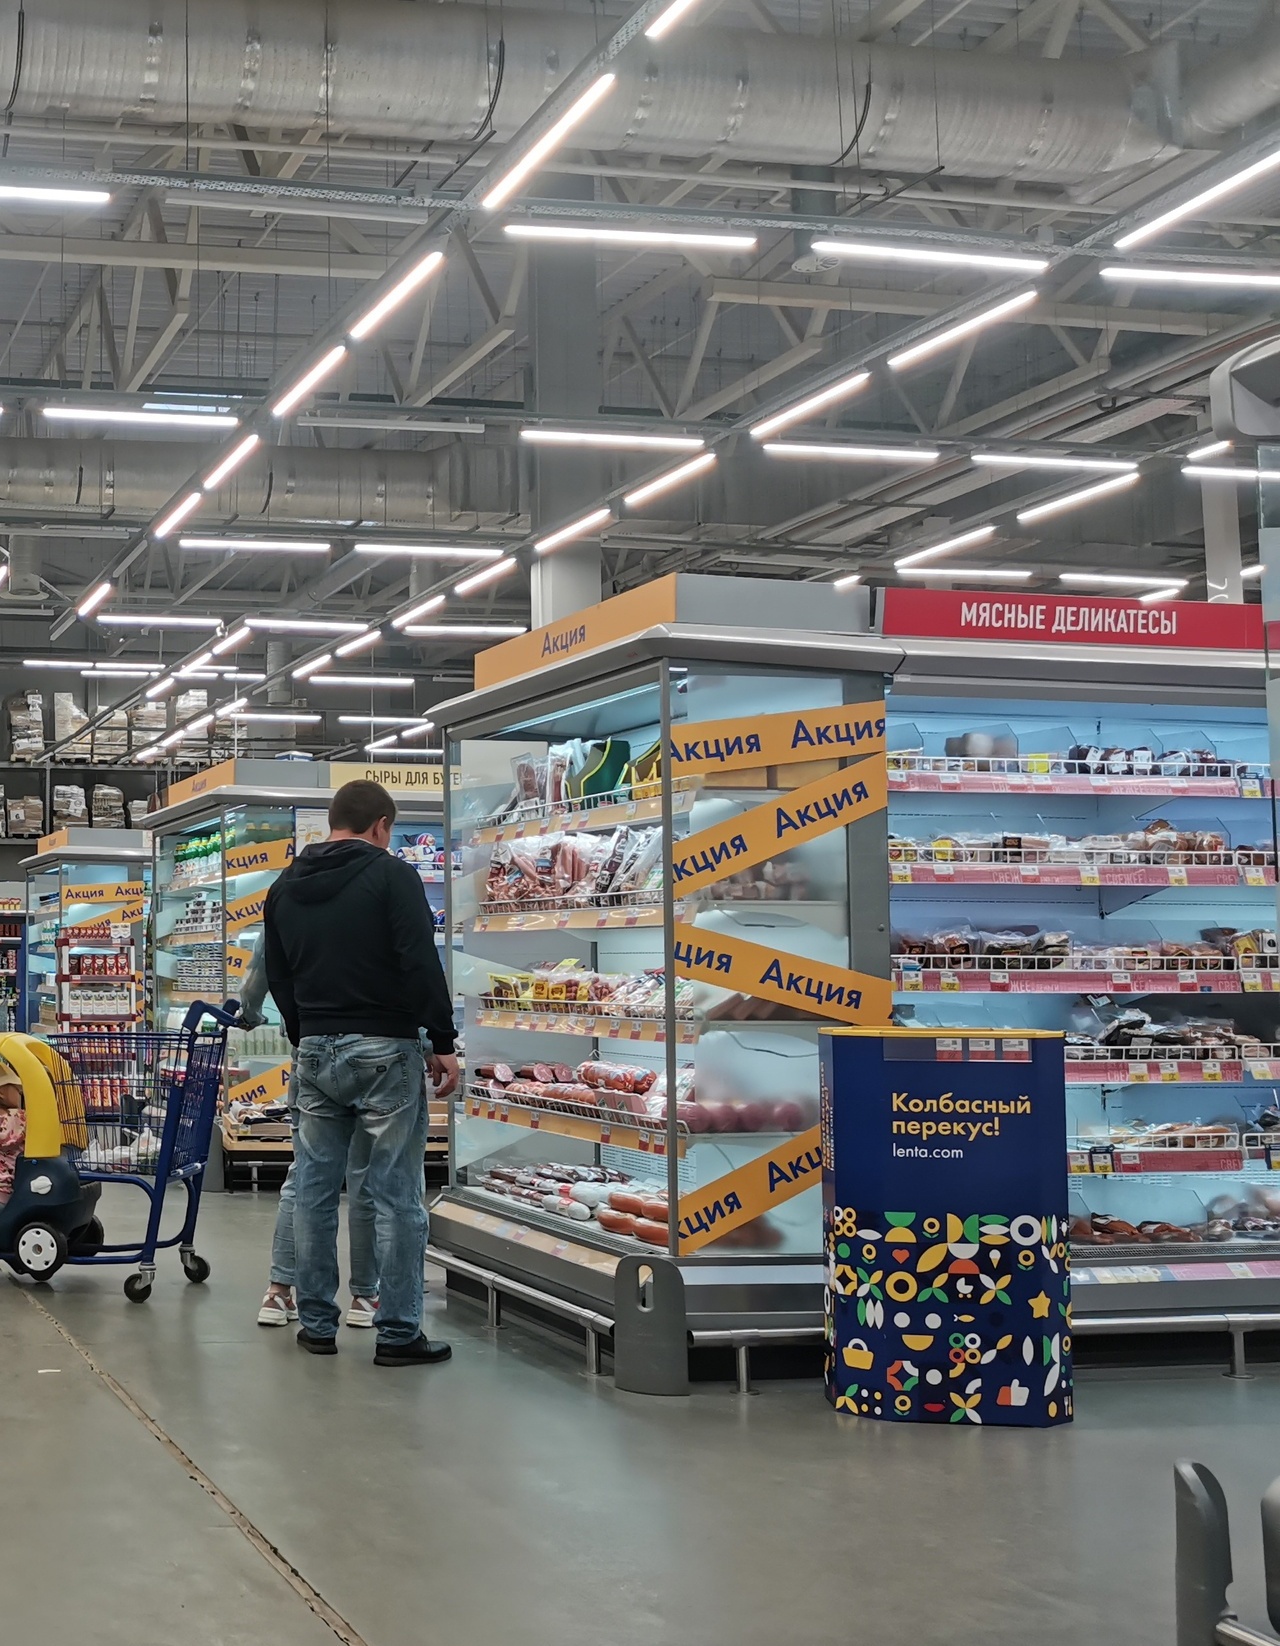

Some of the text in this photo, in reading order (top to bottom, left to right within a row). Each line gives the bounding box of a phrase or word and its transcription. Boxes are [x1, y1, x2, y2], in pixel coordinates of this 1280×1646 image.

[960, 602, 1177, 635] МЯСНЫЕ ДЕЛИКАТЕСЫ
[541, 624, 586, 658] Акция
[671, 733, 762, 763] Акция
[791, 719, 886, 749] Акция
[365, 770, 401, 784] СЫРЫ
[405, 771, 429, 786] ДЛЯ
[776, 780, 870, 838] Акция
[672, 834, 748, 884] кция
[65, 888, 104, 900] Акция
[759, 958, 862, 1010] Акция
[892, 1092, 1031, 1114] Колбасный
[892, 1117, 1000, 1141] перекус!
[892, 1143, 964, 1159] lenta.com
